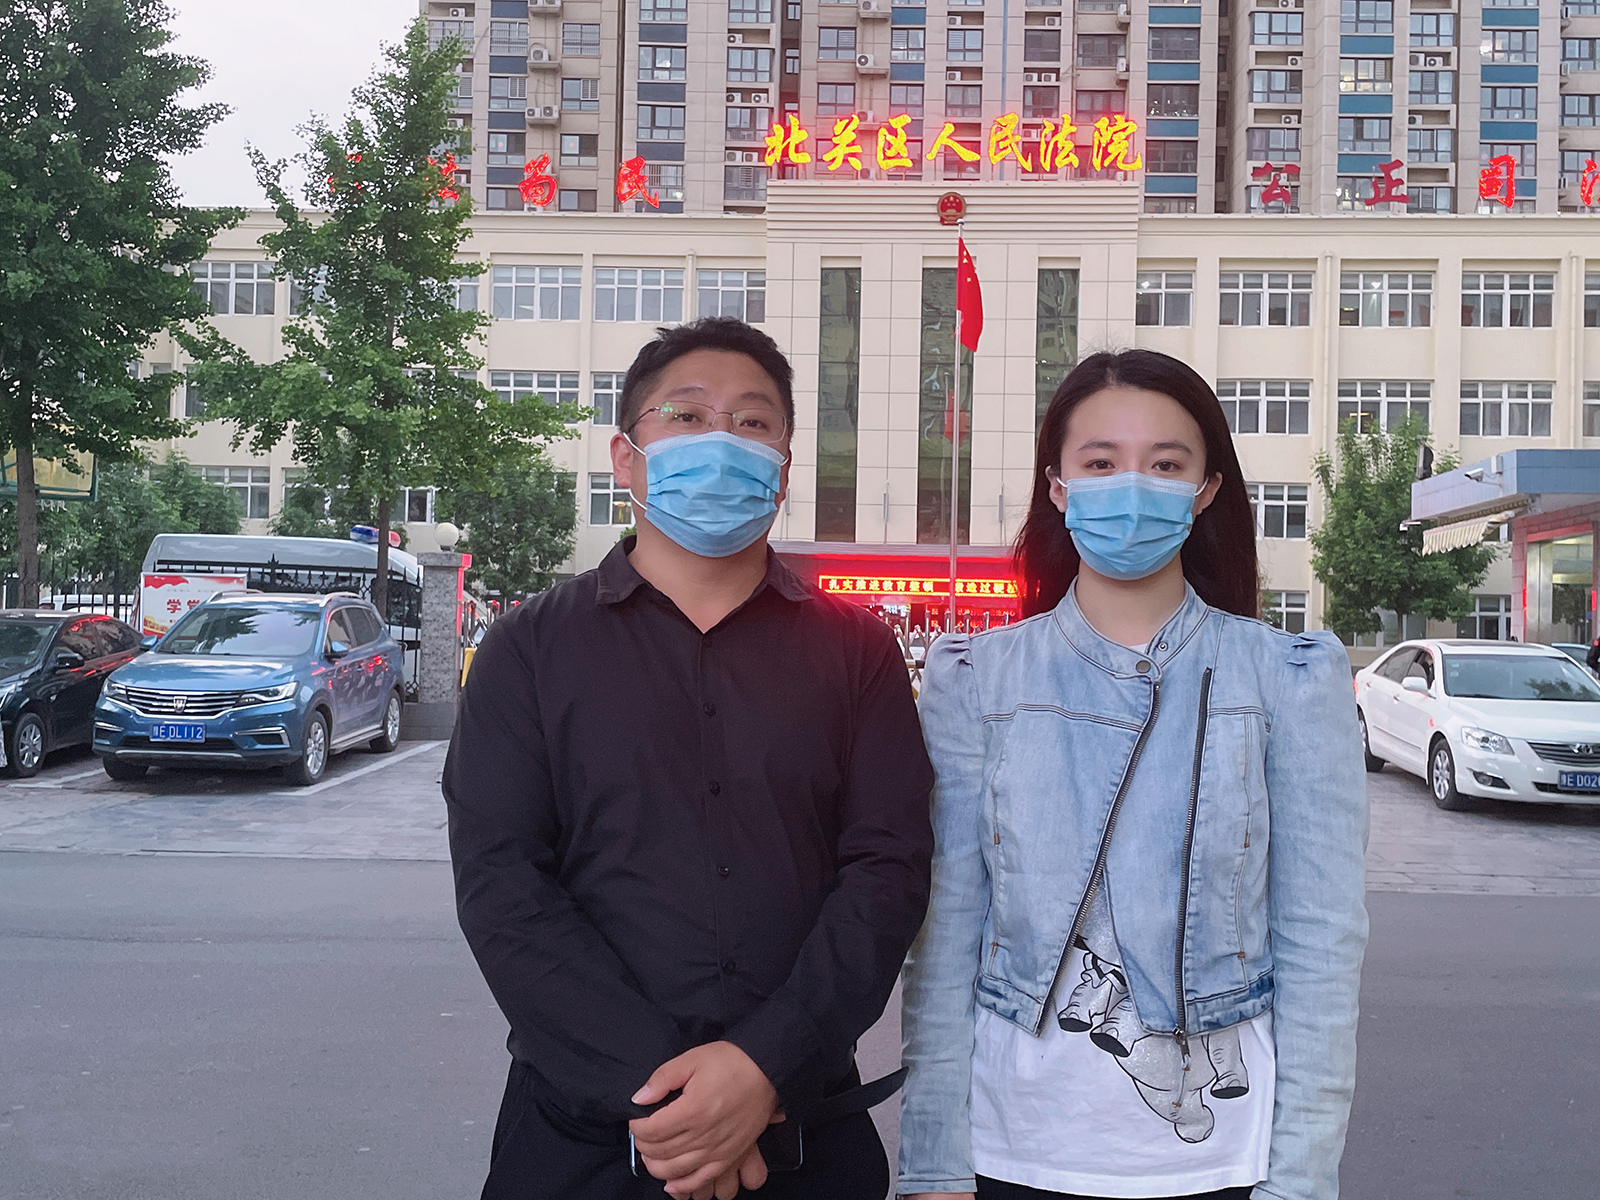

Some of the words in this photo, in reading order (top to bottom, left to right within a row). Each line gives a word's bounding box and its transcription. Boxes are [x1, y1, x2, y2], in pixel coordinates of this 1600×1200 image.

[764, 112, 1143, 172] 北关区人民法院
[829, 579, 934, 593] 扎实推进教育整顿
[1560, 773, 1600, 788] ED02
